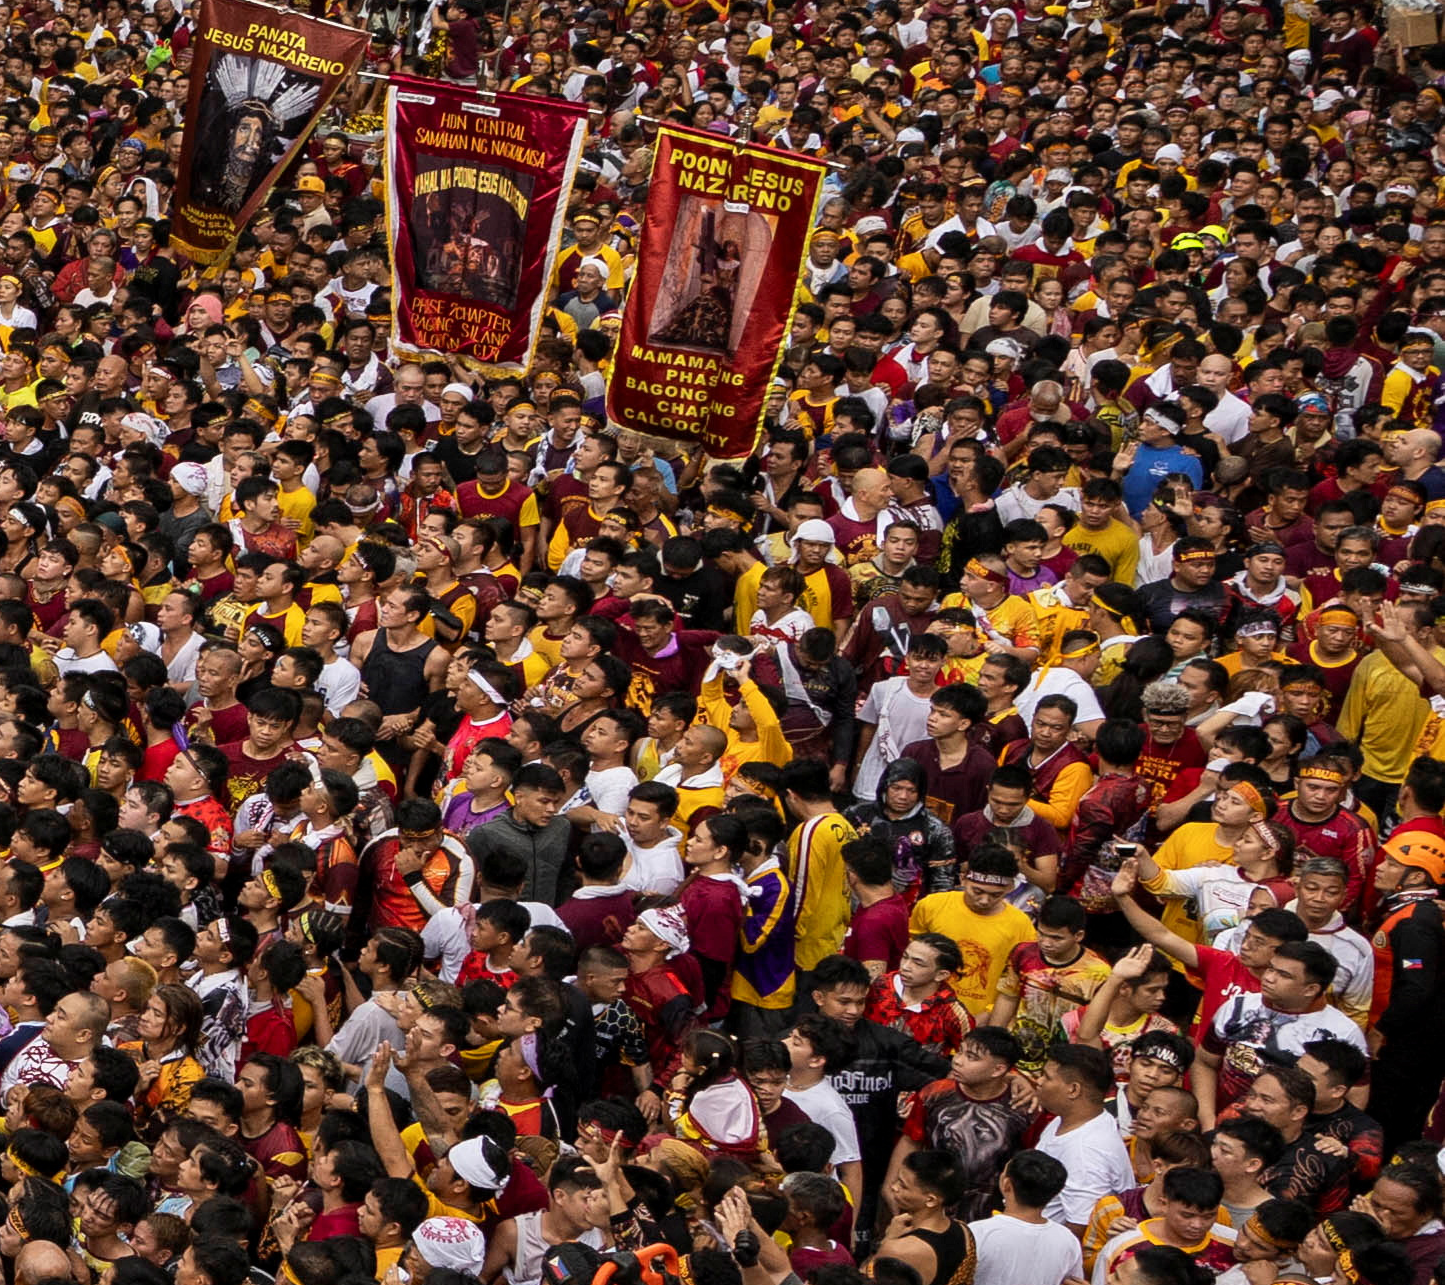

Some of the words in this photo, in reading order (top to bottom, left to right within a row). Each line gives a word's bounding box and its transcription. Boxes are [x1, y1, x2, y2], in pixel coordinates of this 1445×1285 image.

[247, 24, 306, 51] PANATA
[204, 28, 254, 52] JESUS
[259, 41, 345, 76] NAZARENO
[440, 112, 467, 130] HDN
[475, 117, 527, 142] CENTRAL
[415, 127, 468, 150] SAMAHAN
[471, 137, 488, 155] NG
[440, 168, 452, 191] NA
[453, 166, 477, 190] POONG
[743, 167, 804, 196] JESUS
[455, 307, 512, 333] CHAPTER
[461, 323, 511, 347] SILANG
[626, 376, 707, 402] BAGONG
